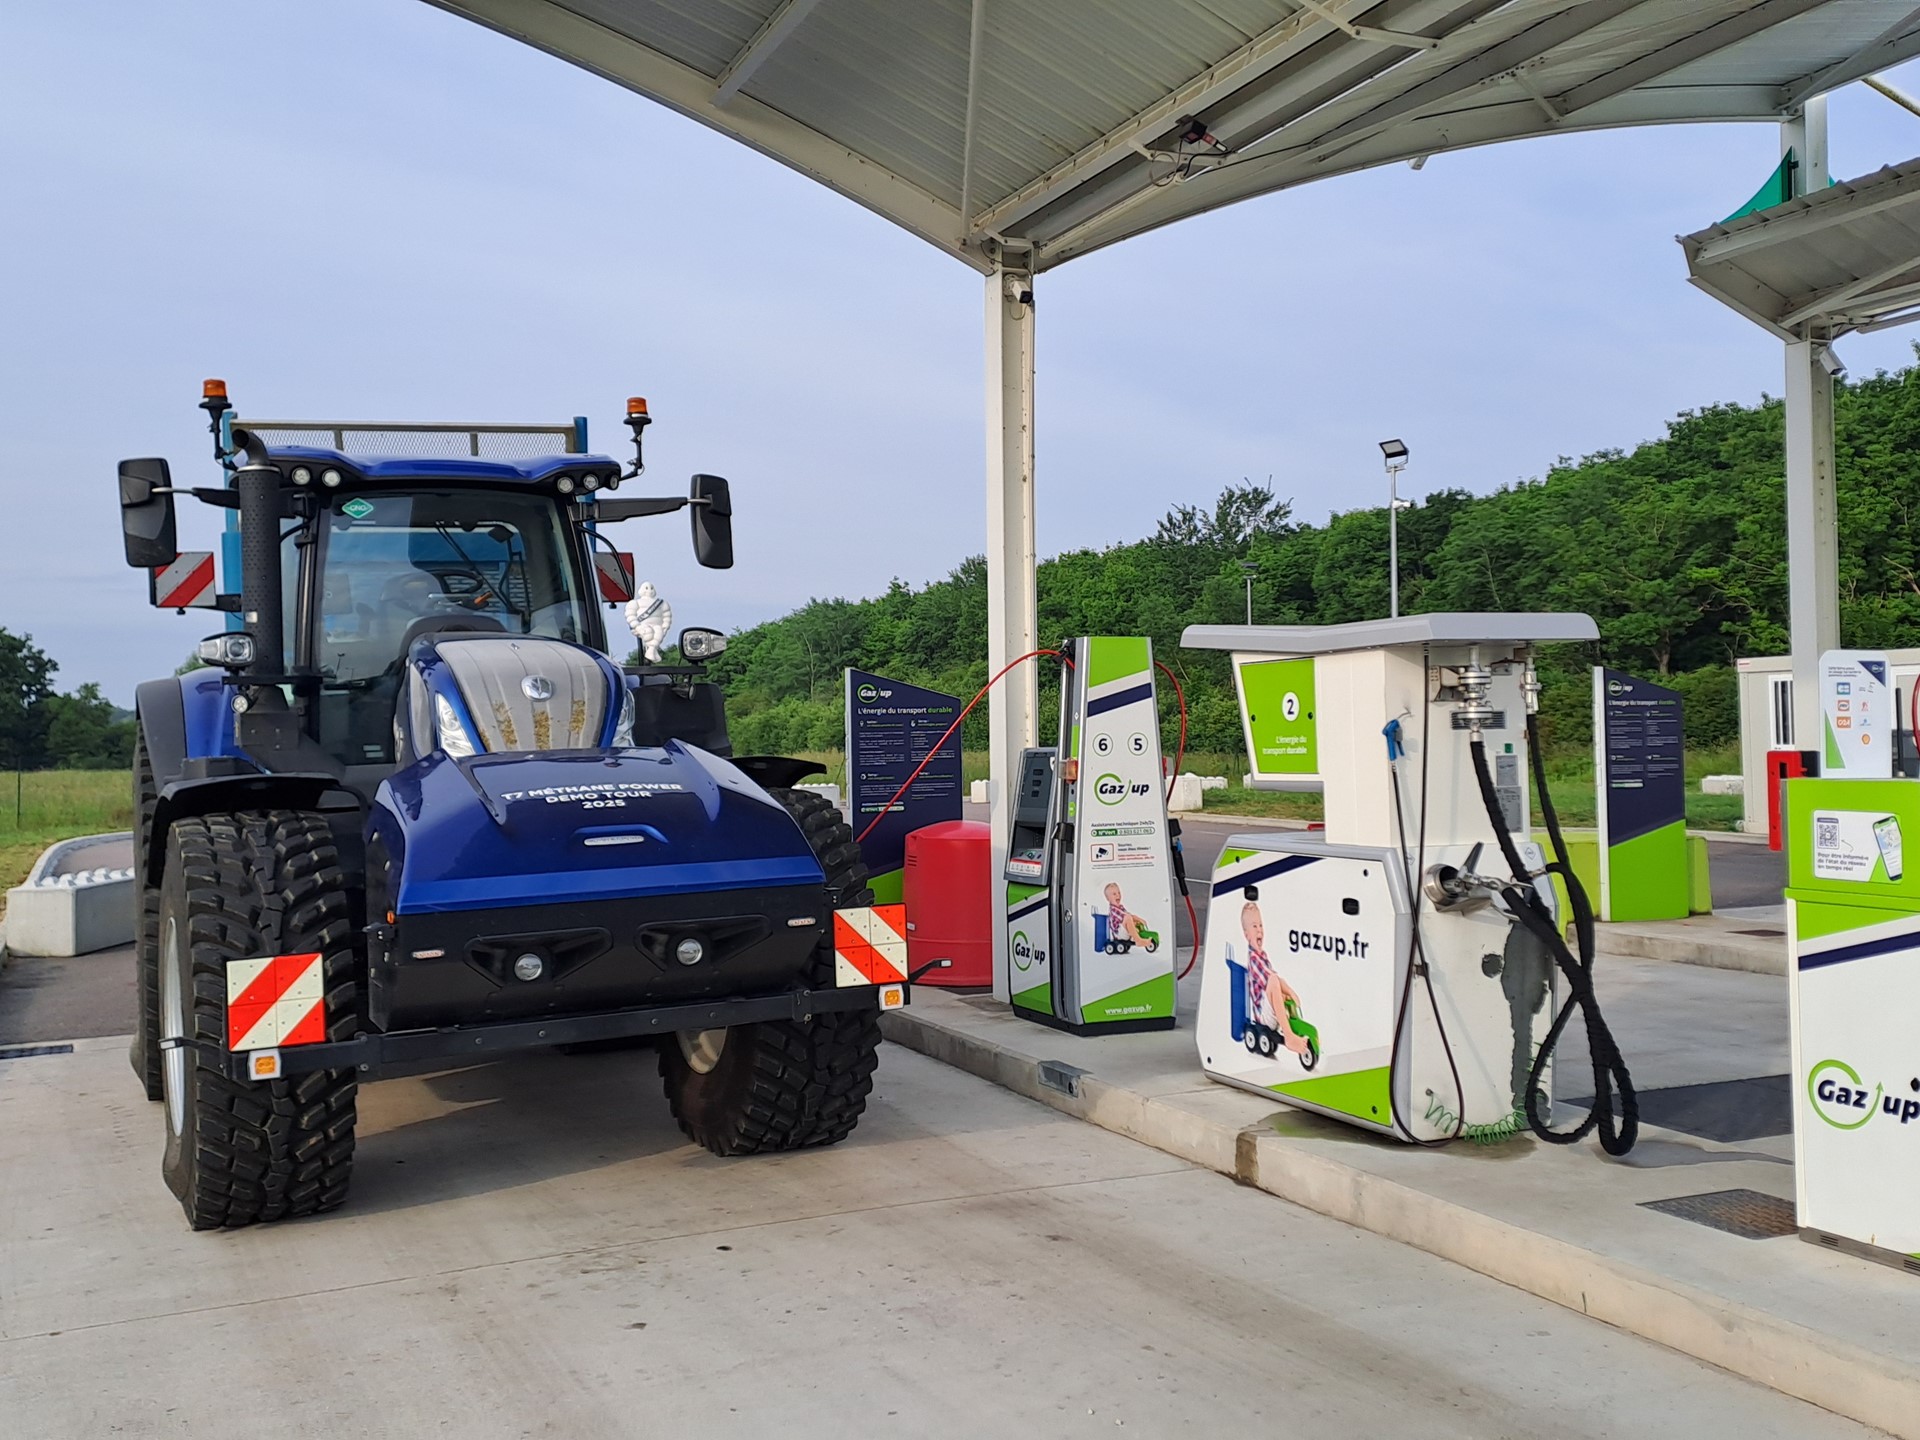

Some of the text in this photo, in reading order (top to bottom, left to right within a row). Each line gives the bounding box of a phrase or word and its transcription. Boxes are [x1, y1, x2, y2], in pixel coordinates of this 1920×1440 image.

[860, 689, 892, 698] Gaz up
[858, 707, 887, 716] L'énergie
[897, 707, 927, 715] transport
[927, 706, 953, 714] durable
[1286, 698, 1295, 715] 2
[1098, 738, 1143, 751] 6 5
[501, 783, 683, 801] T7 MÉTHANE POWER
[1098, 783, 1150, 796] Gaz up
[545, 790, 652, 804] DEMO TOUR
[582, 800, 626, 809] 2025
[1289, 929, 1369, 961] gazup.fr
[1015, 942, 1046, 965] Gaz up
[1817, 1079, 1920, 1124] Gaz up
